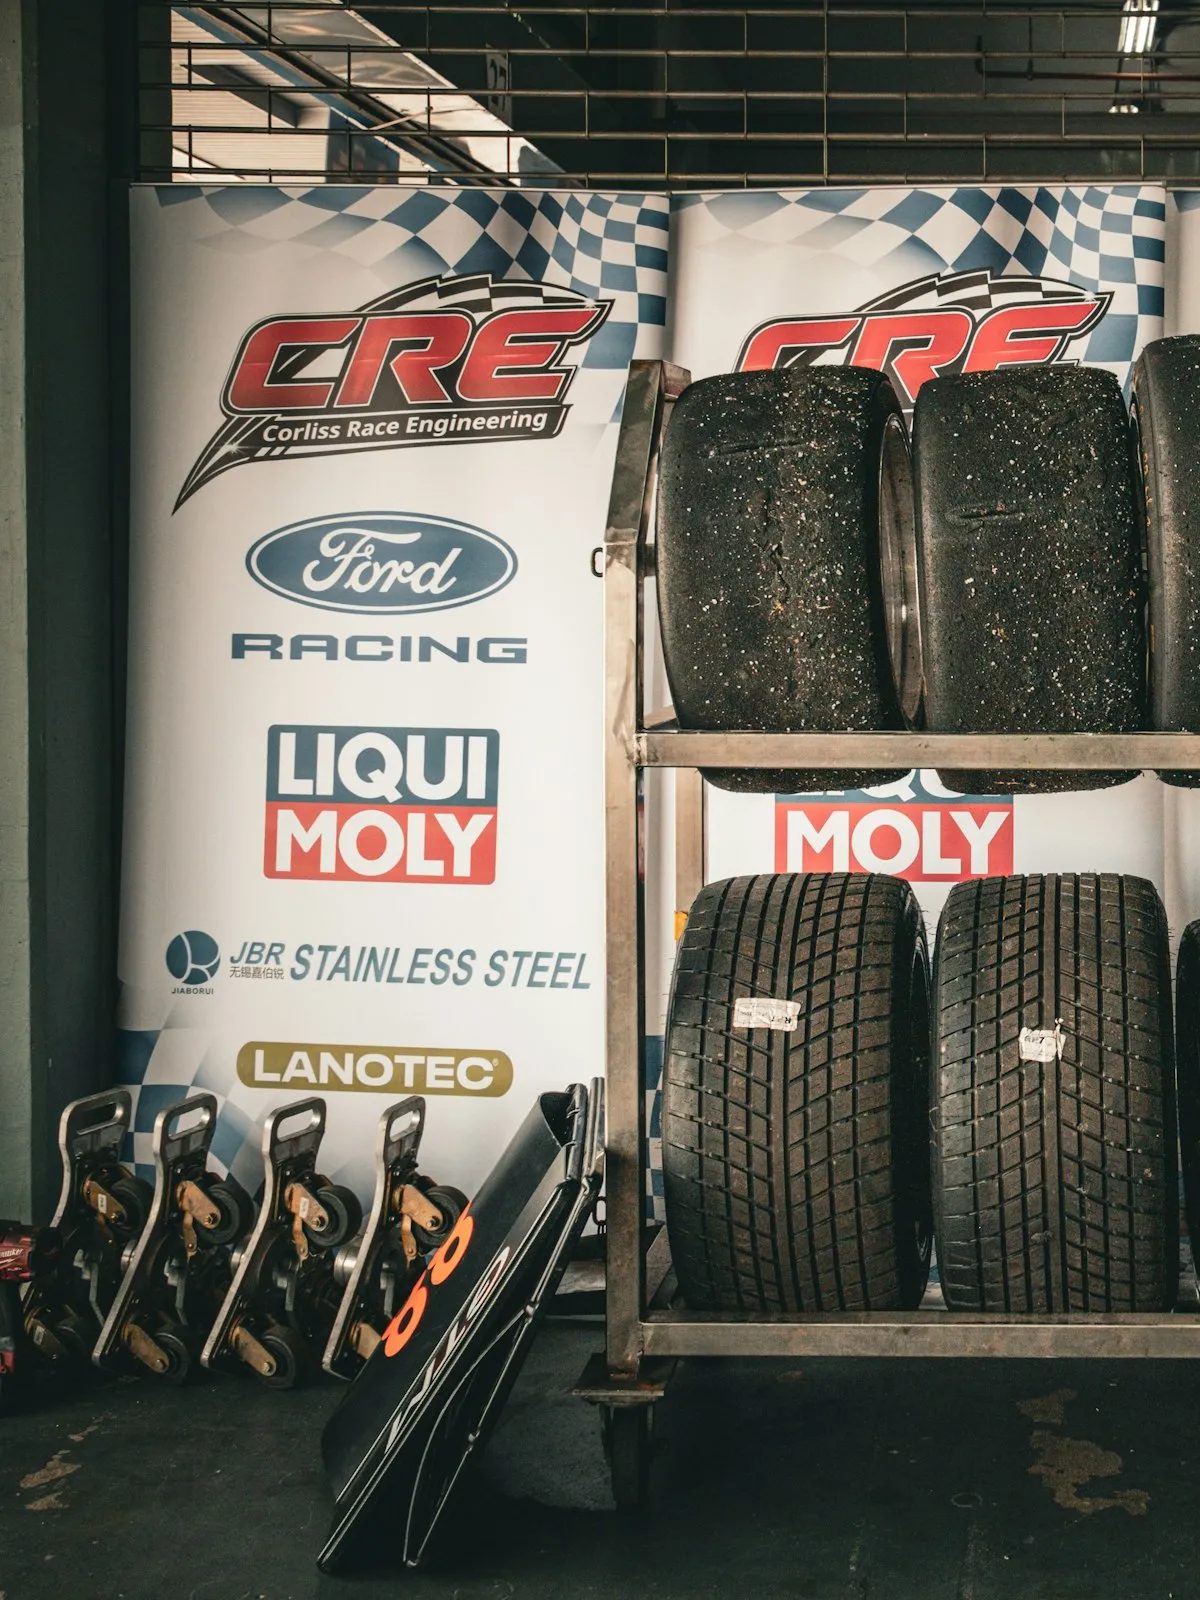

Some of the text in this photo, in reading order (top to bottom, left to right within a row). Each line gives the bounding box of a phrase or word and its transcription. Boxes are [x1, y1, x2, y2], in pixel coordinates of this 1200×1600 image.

[227, 306, 600, 409] CRE
[262, 410, 548, 442] Corliss Race Engineering
[302, 527, 464, 596] Ford
[231, 632, 528, 665] RACING
[277, 731, 489, 804] LIQUI
[274, 808, 494, 878] MOLY
[786, 808, 1011, 877] MOLY
[171, 986, 215, 996] JIABORUI
[229, 941, 592, 990] JBR STAINLESS STEEL
[253, 1048, 494, 1090] LANOTEC
